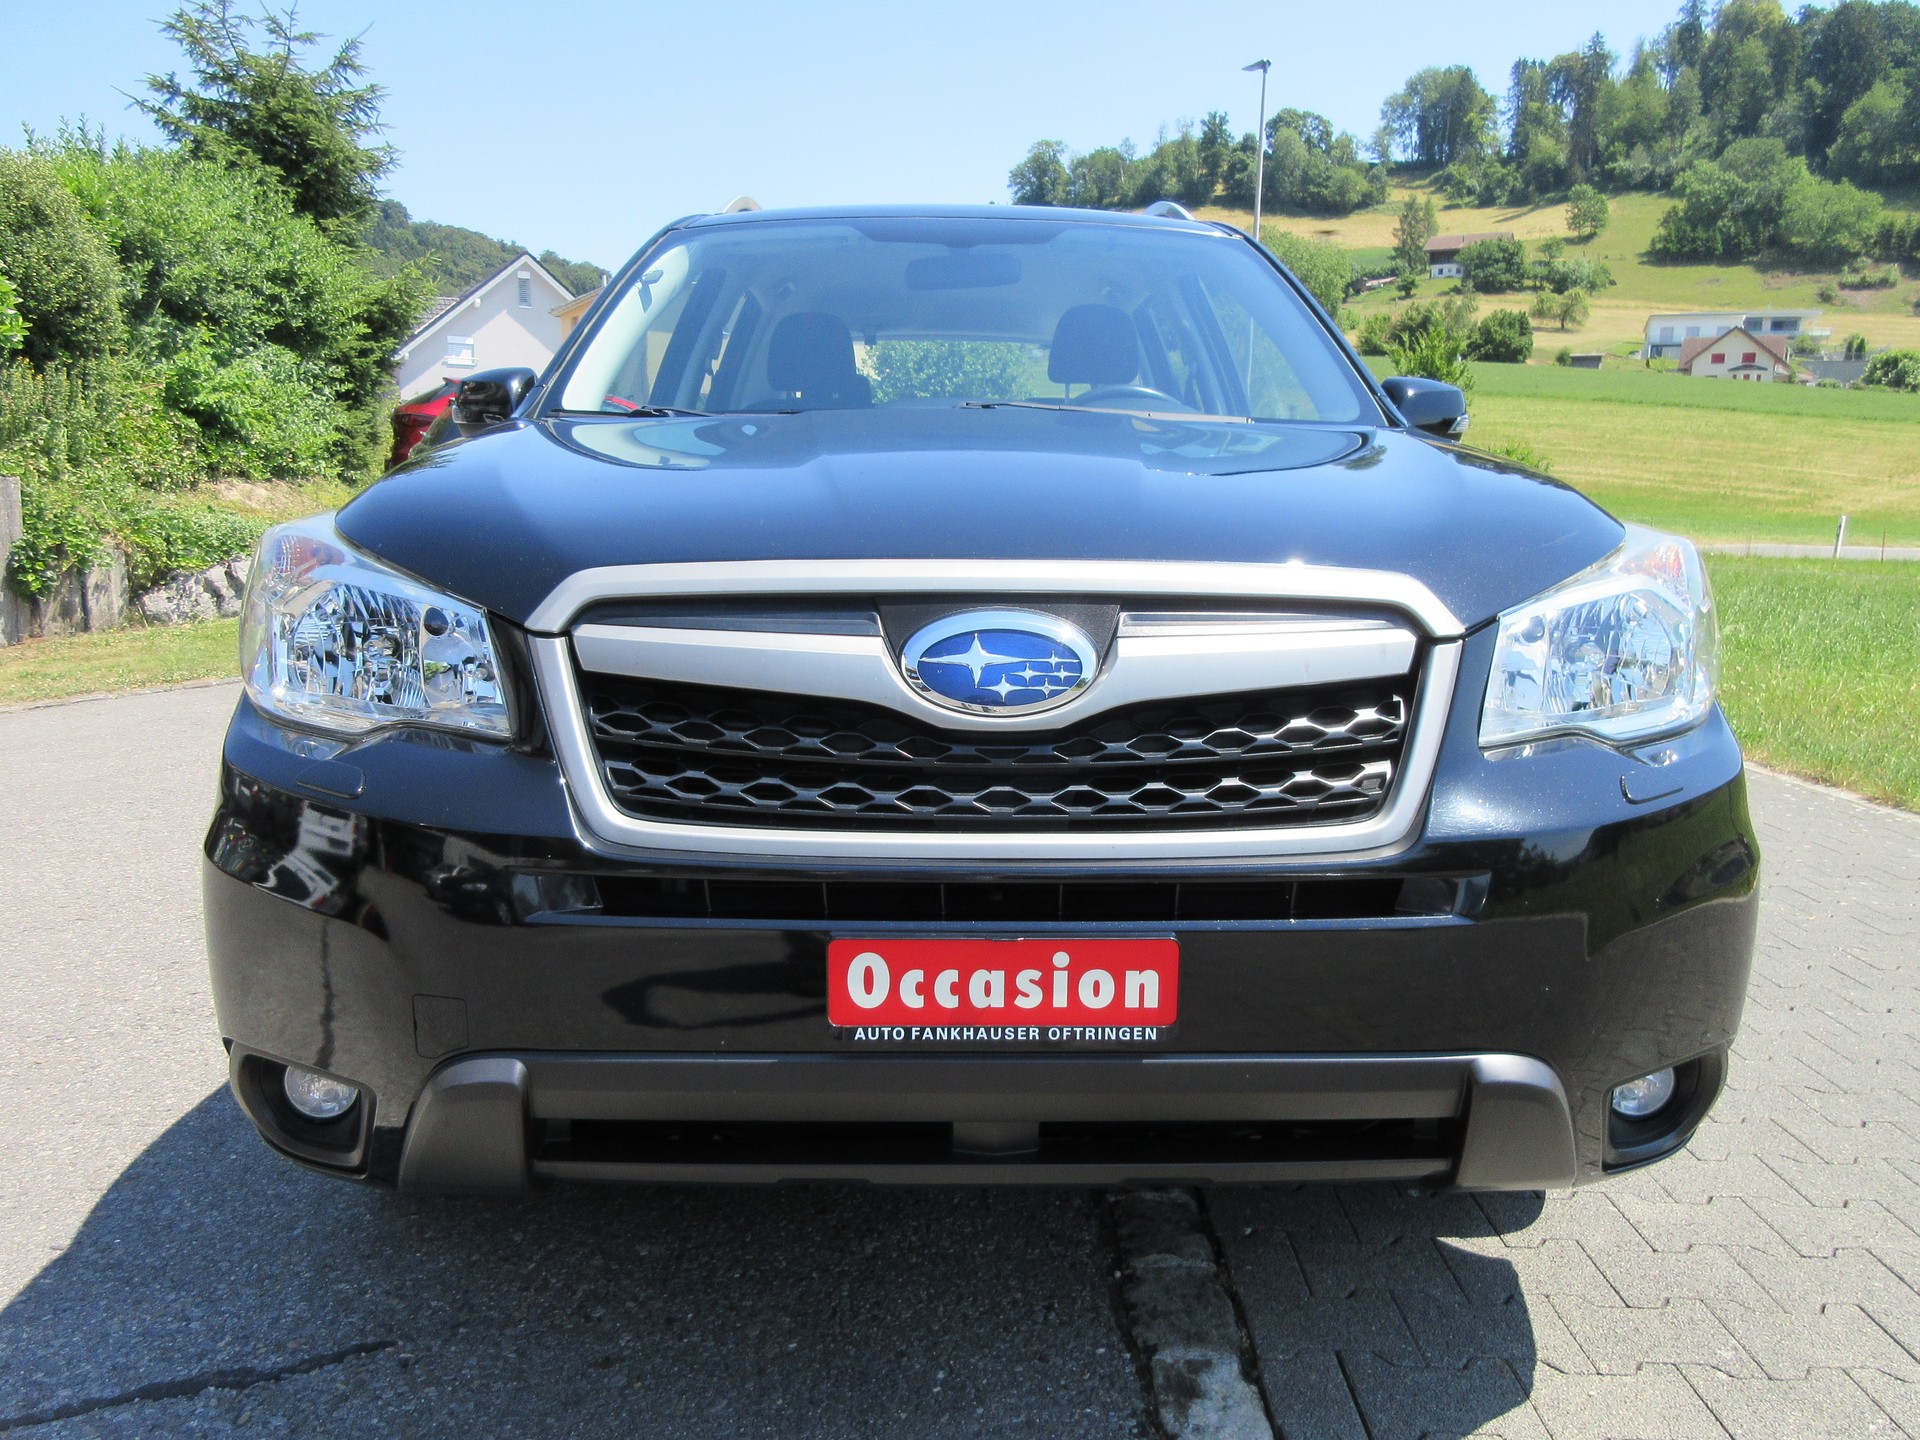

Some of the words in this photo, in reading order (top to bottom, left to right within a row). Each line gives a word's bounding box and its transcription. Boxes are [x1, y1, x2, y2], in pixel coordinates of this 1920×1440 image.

[846, 951, 1160, 1009] Occasion
[854, 1026, 905, 1041] AUTO
[911, 1026, 1041, 1041] FANKHAUSER
[1048, 1026, 1158, 1041] OFTRINGEN
